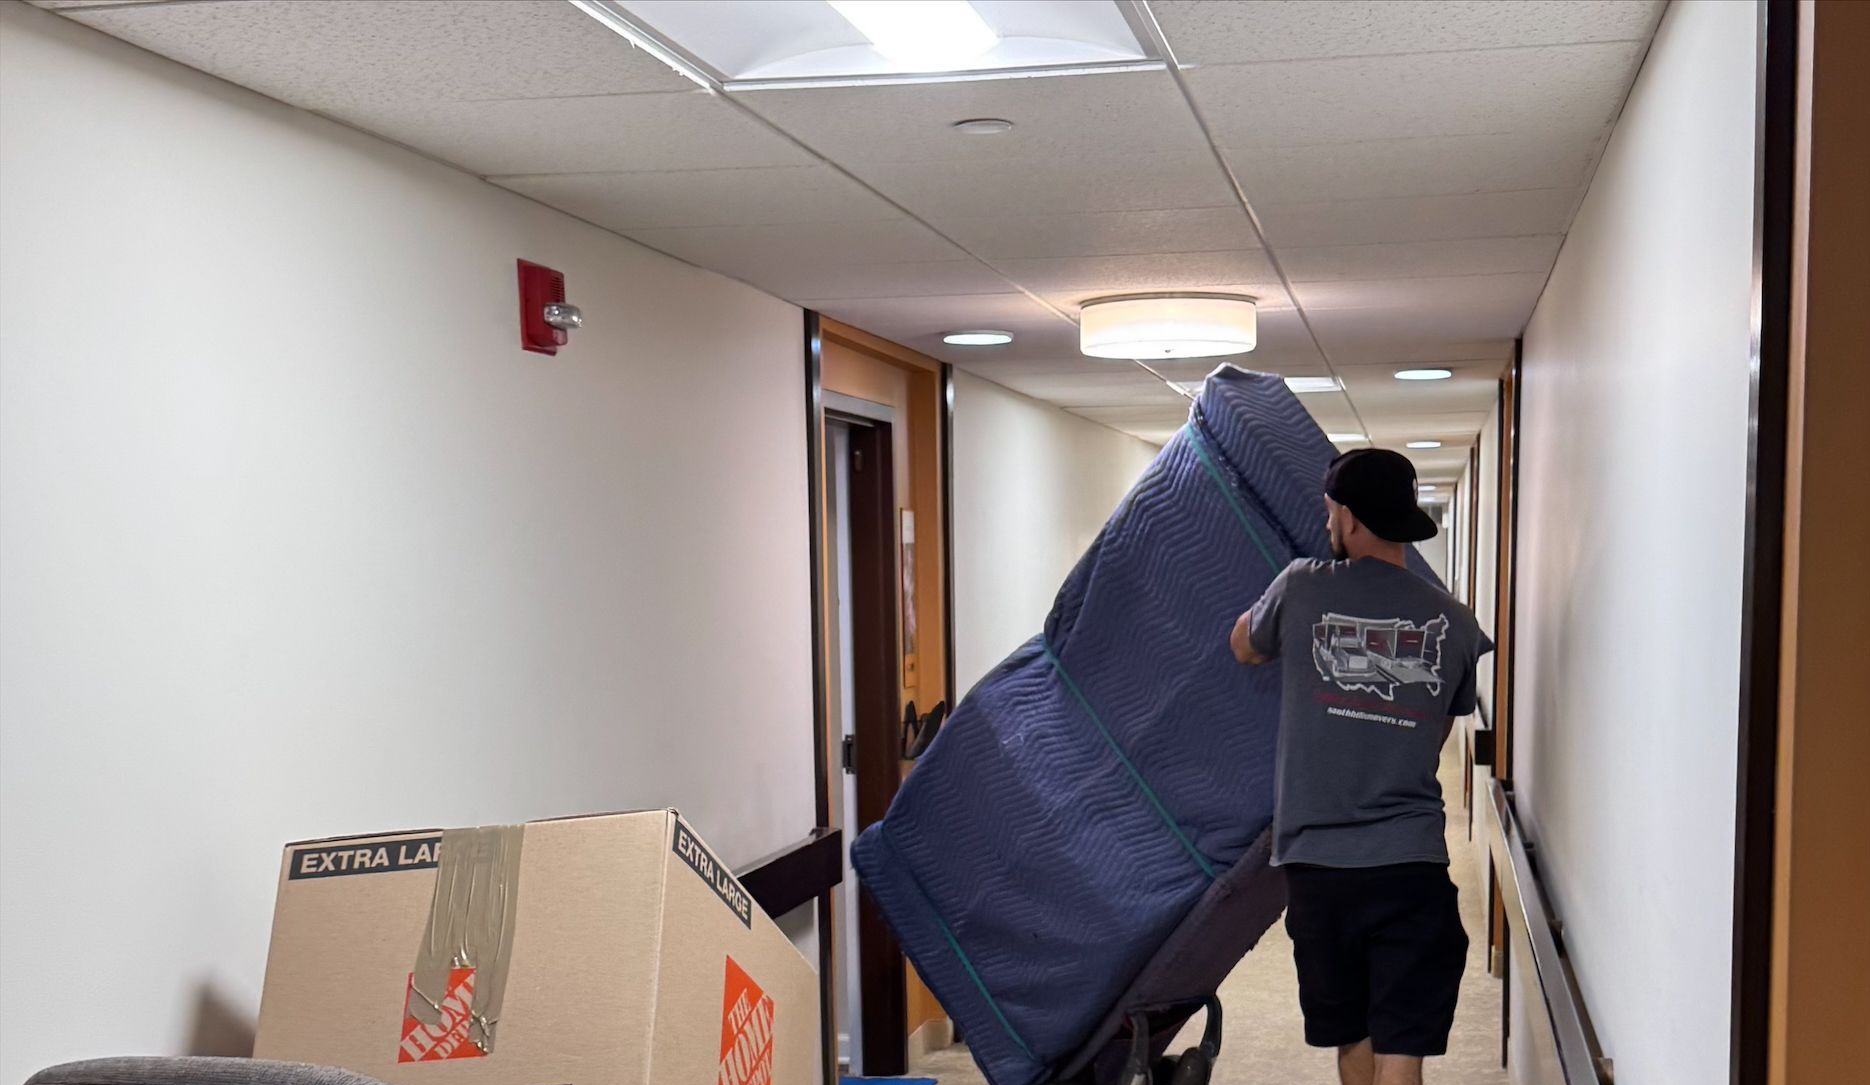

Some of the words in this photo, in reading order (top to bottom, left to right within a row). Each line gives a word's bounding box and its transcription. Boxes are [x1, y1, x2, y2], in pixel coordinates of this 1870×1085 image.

[300, 847, 390, 874] EXTRA
[678, 829, 714, 883] EXTRA
[716, 870, 748, 920] LARGE
[728, 987, 752, 1035] THE
